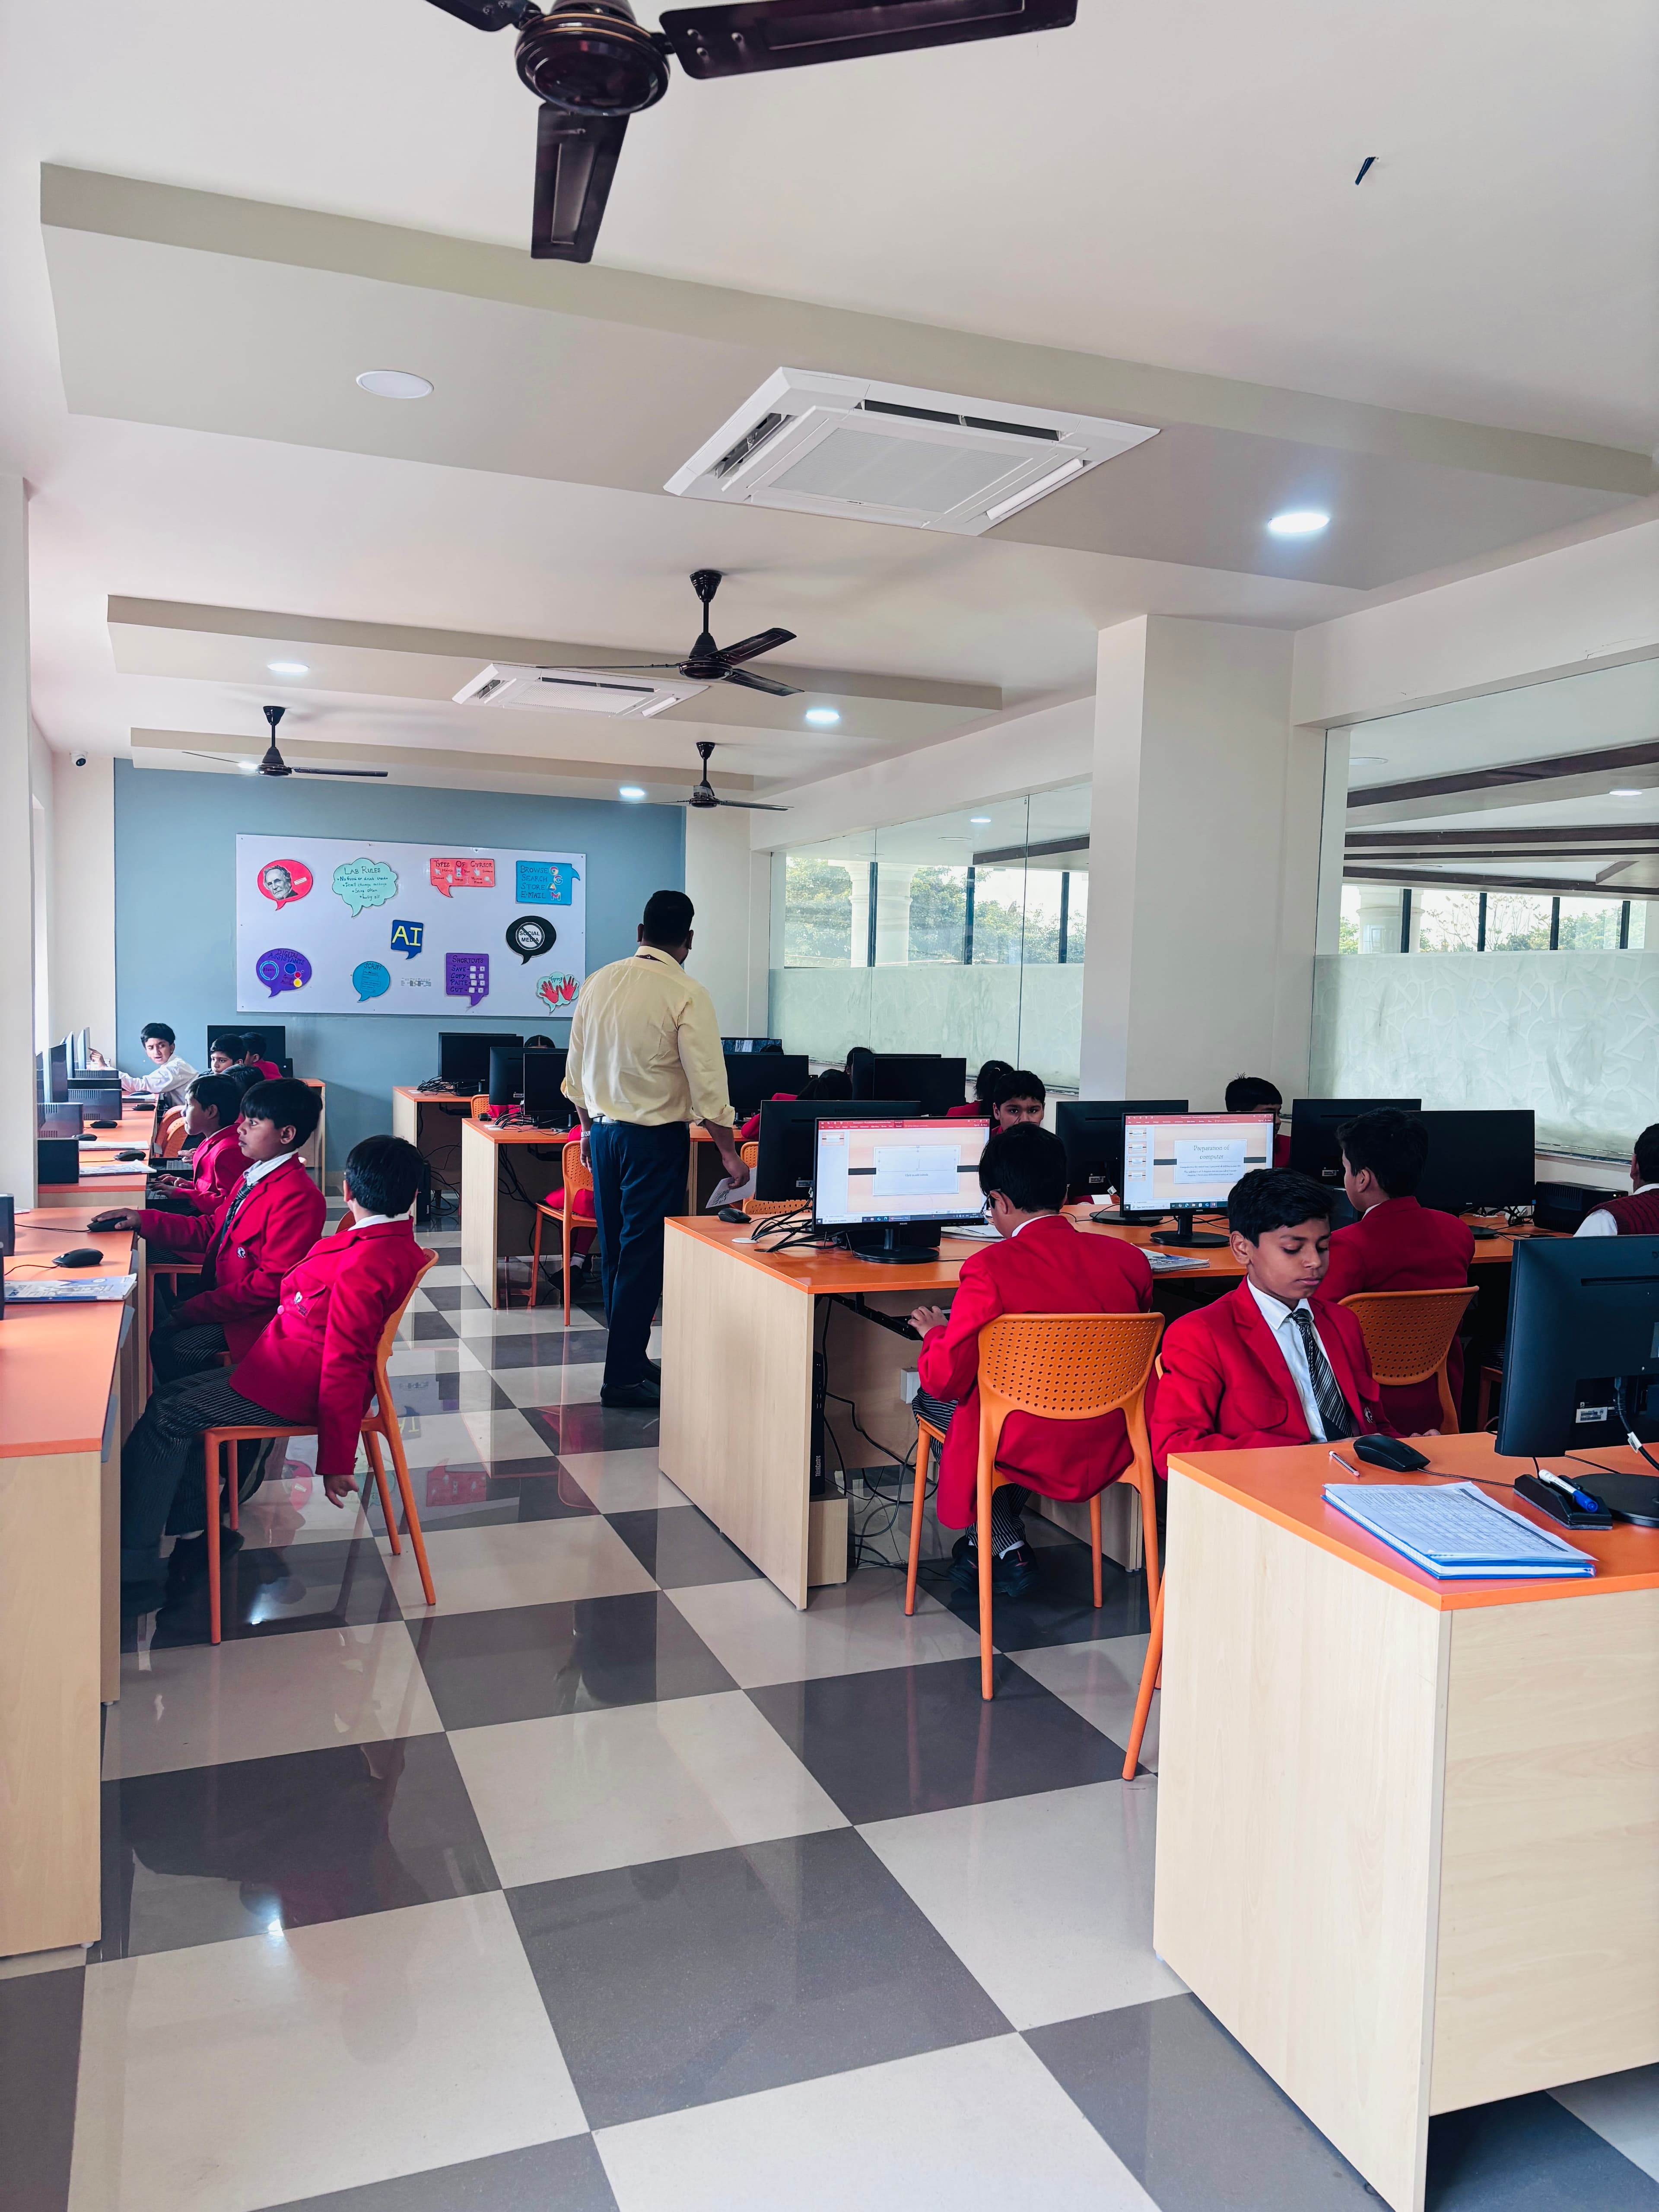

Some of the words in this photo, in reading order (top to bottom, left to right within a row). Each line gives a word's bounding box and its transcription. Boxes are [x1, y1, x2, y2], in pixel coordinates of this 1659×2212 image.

[521, 874, 547, 882] SEARCH
[391, 925, 422, 946] AI
[268, 953, 305, 965] ASSISTANTS
[452, 955, 484, 963] SHORTCUTS
